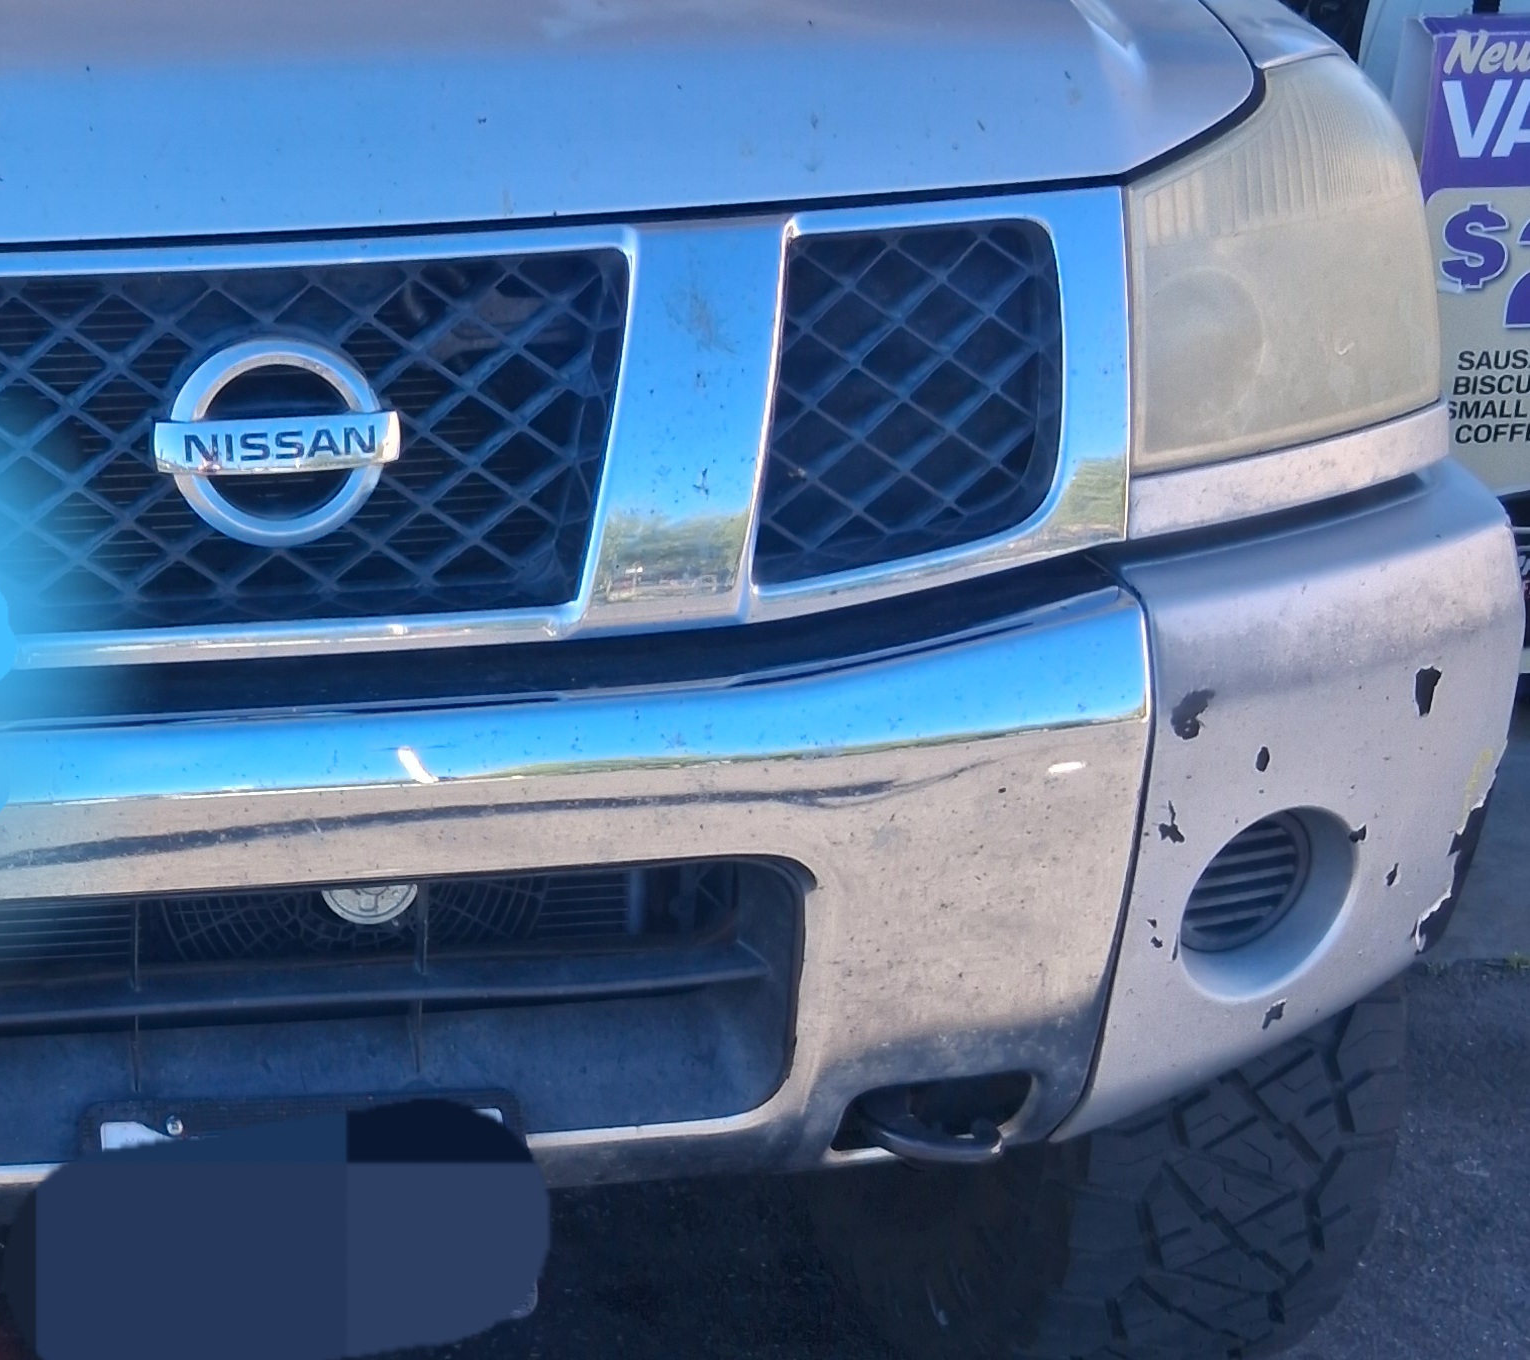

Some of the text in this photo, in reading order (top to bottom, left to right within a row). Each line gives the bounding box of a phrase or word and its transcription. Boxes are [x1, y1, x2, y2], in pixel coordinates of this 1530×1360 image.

[1457, 349, 1530, 371] SAUS
[1448, 399, 1528, 420] SMALL
[183, 425, 377, 463] NISSAN
